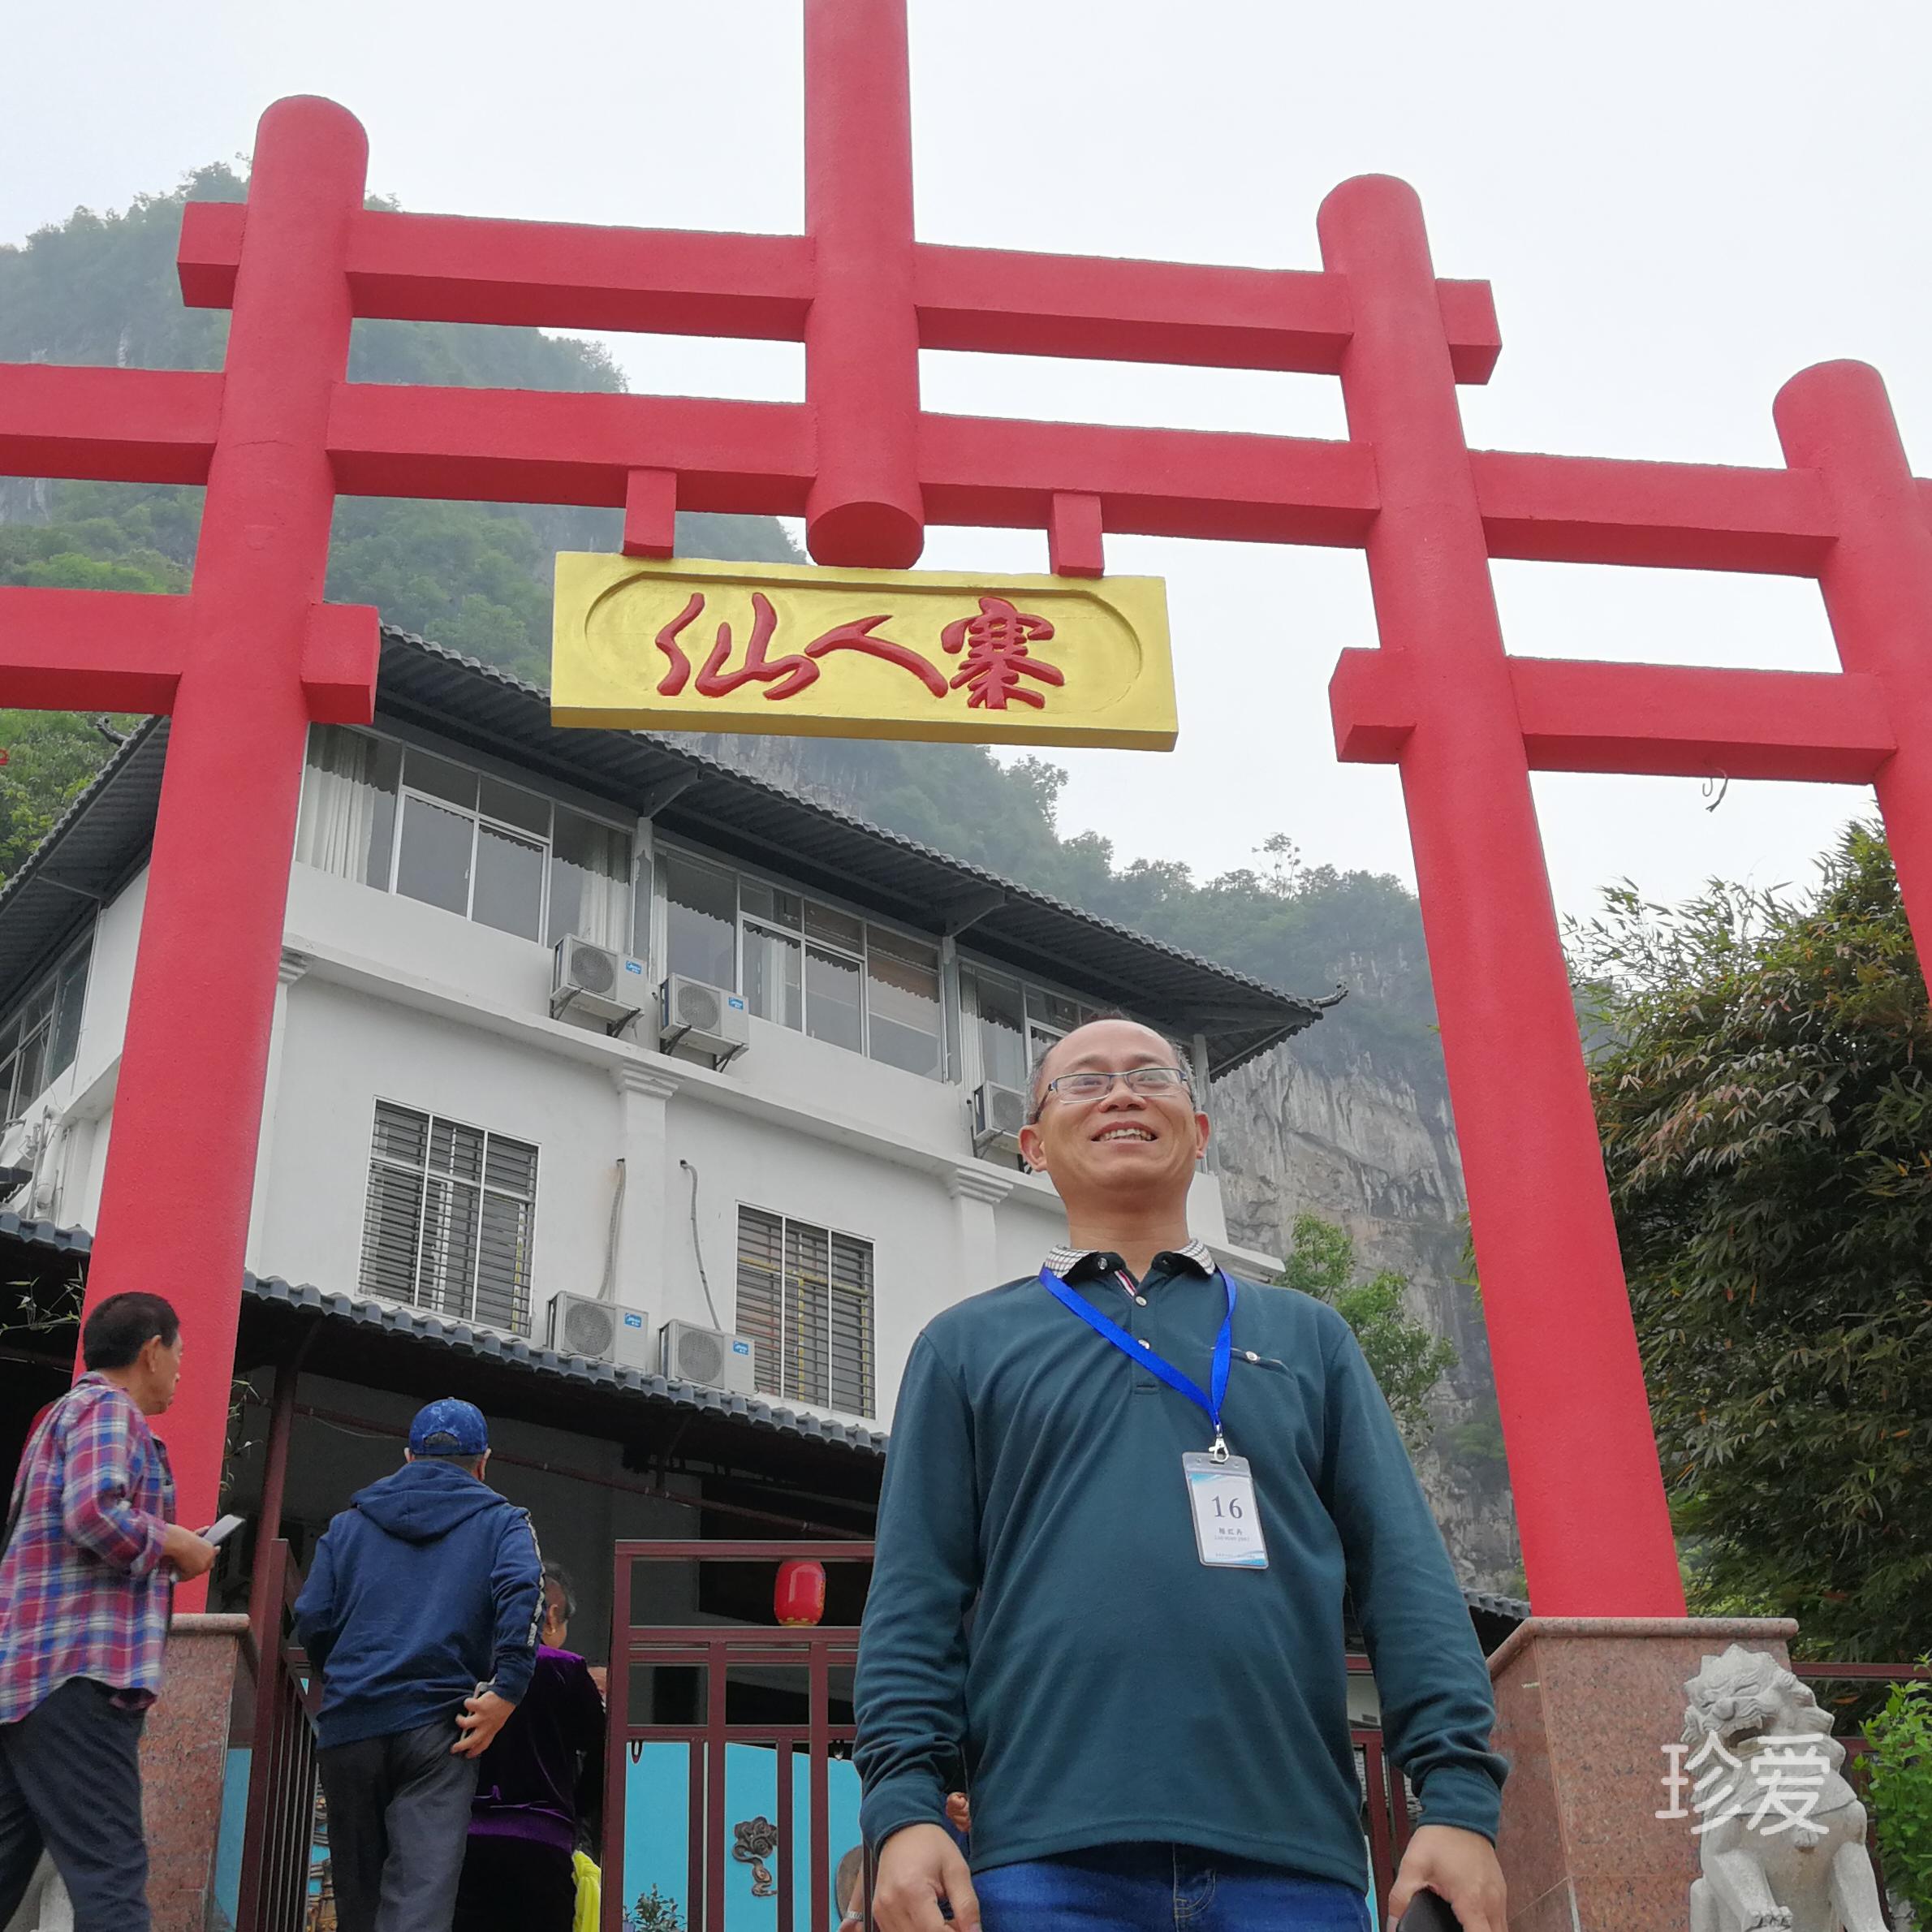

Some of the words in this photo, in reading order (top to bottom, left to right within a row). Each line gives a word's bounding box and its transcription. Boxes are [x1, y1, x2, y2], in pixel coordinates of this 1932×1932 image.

[655, 592, 1065, 709] 仙人寨
[1211, 1495, 1243, 1519] 16
